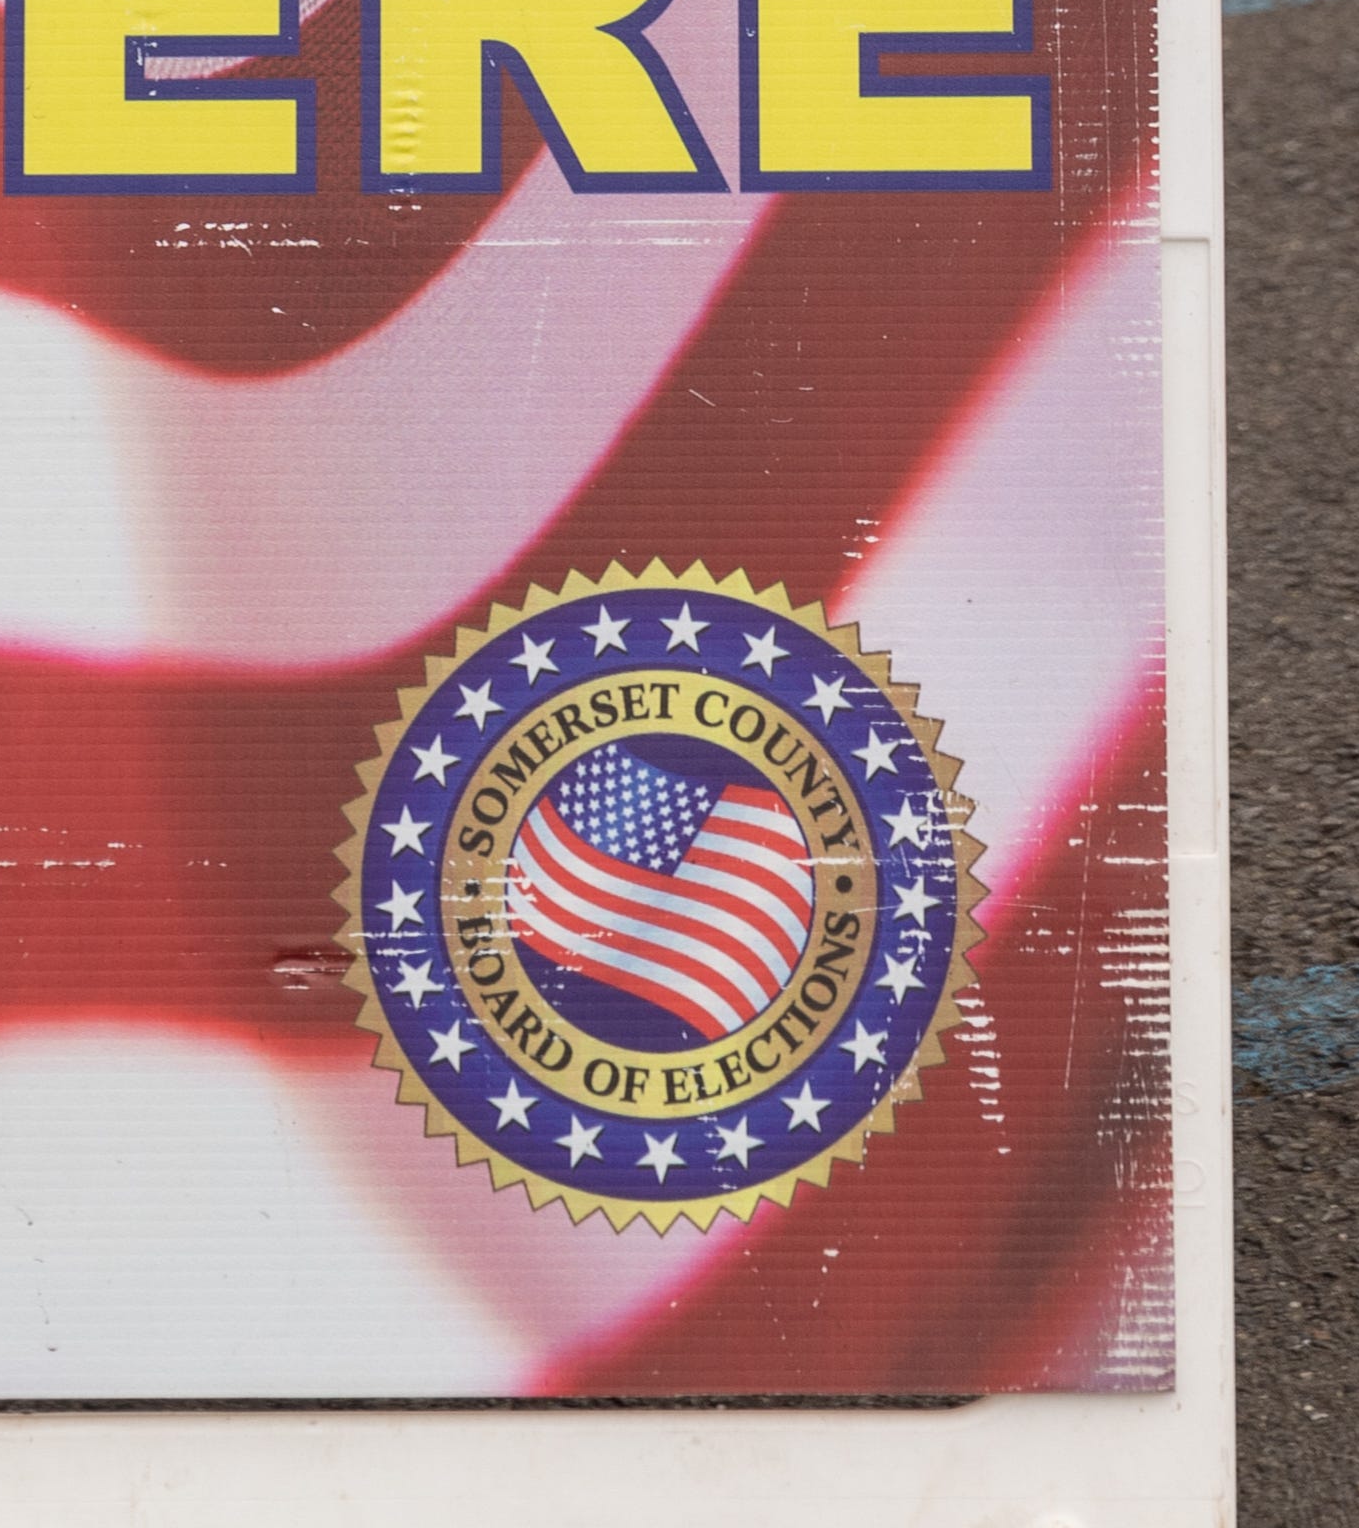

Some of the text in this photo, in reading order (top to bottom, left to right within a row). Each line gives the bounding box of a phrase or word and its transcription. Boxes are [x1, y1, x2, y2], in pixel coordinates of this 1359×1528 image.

[457, 682, 862, 859] SOMERSET COUNTY
[456, 909, 862, 1107] BOARD OF ELECTIONS
